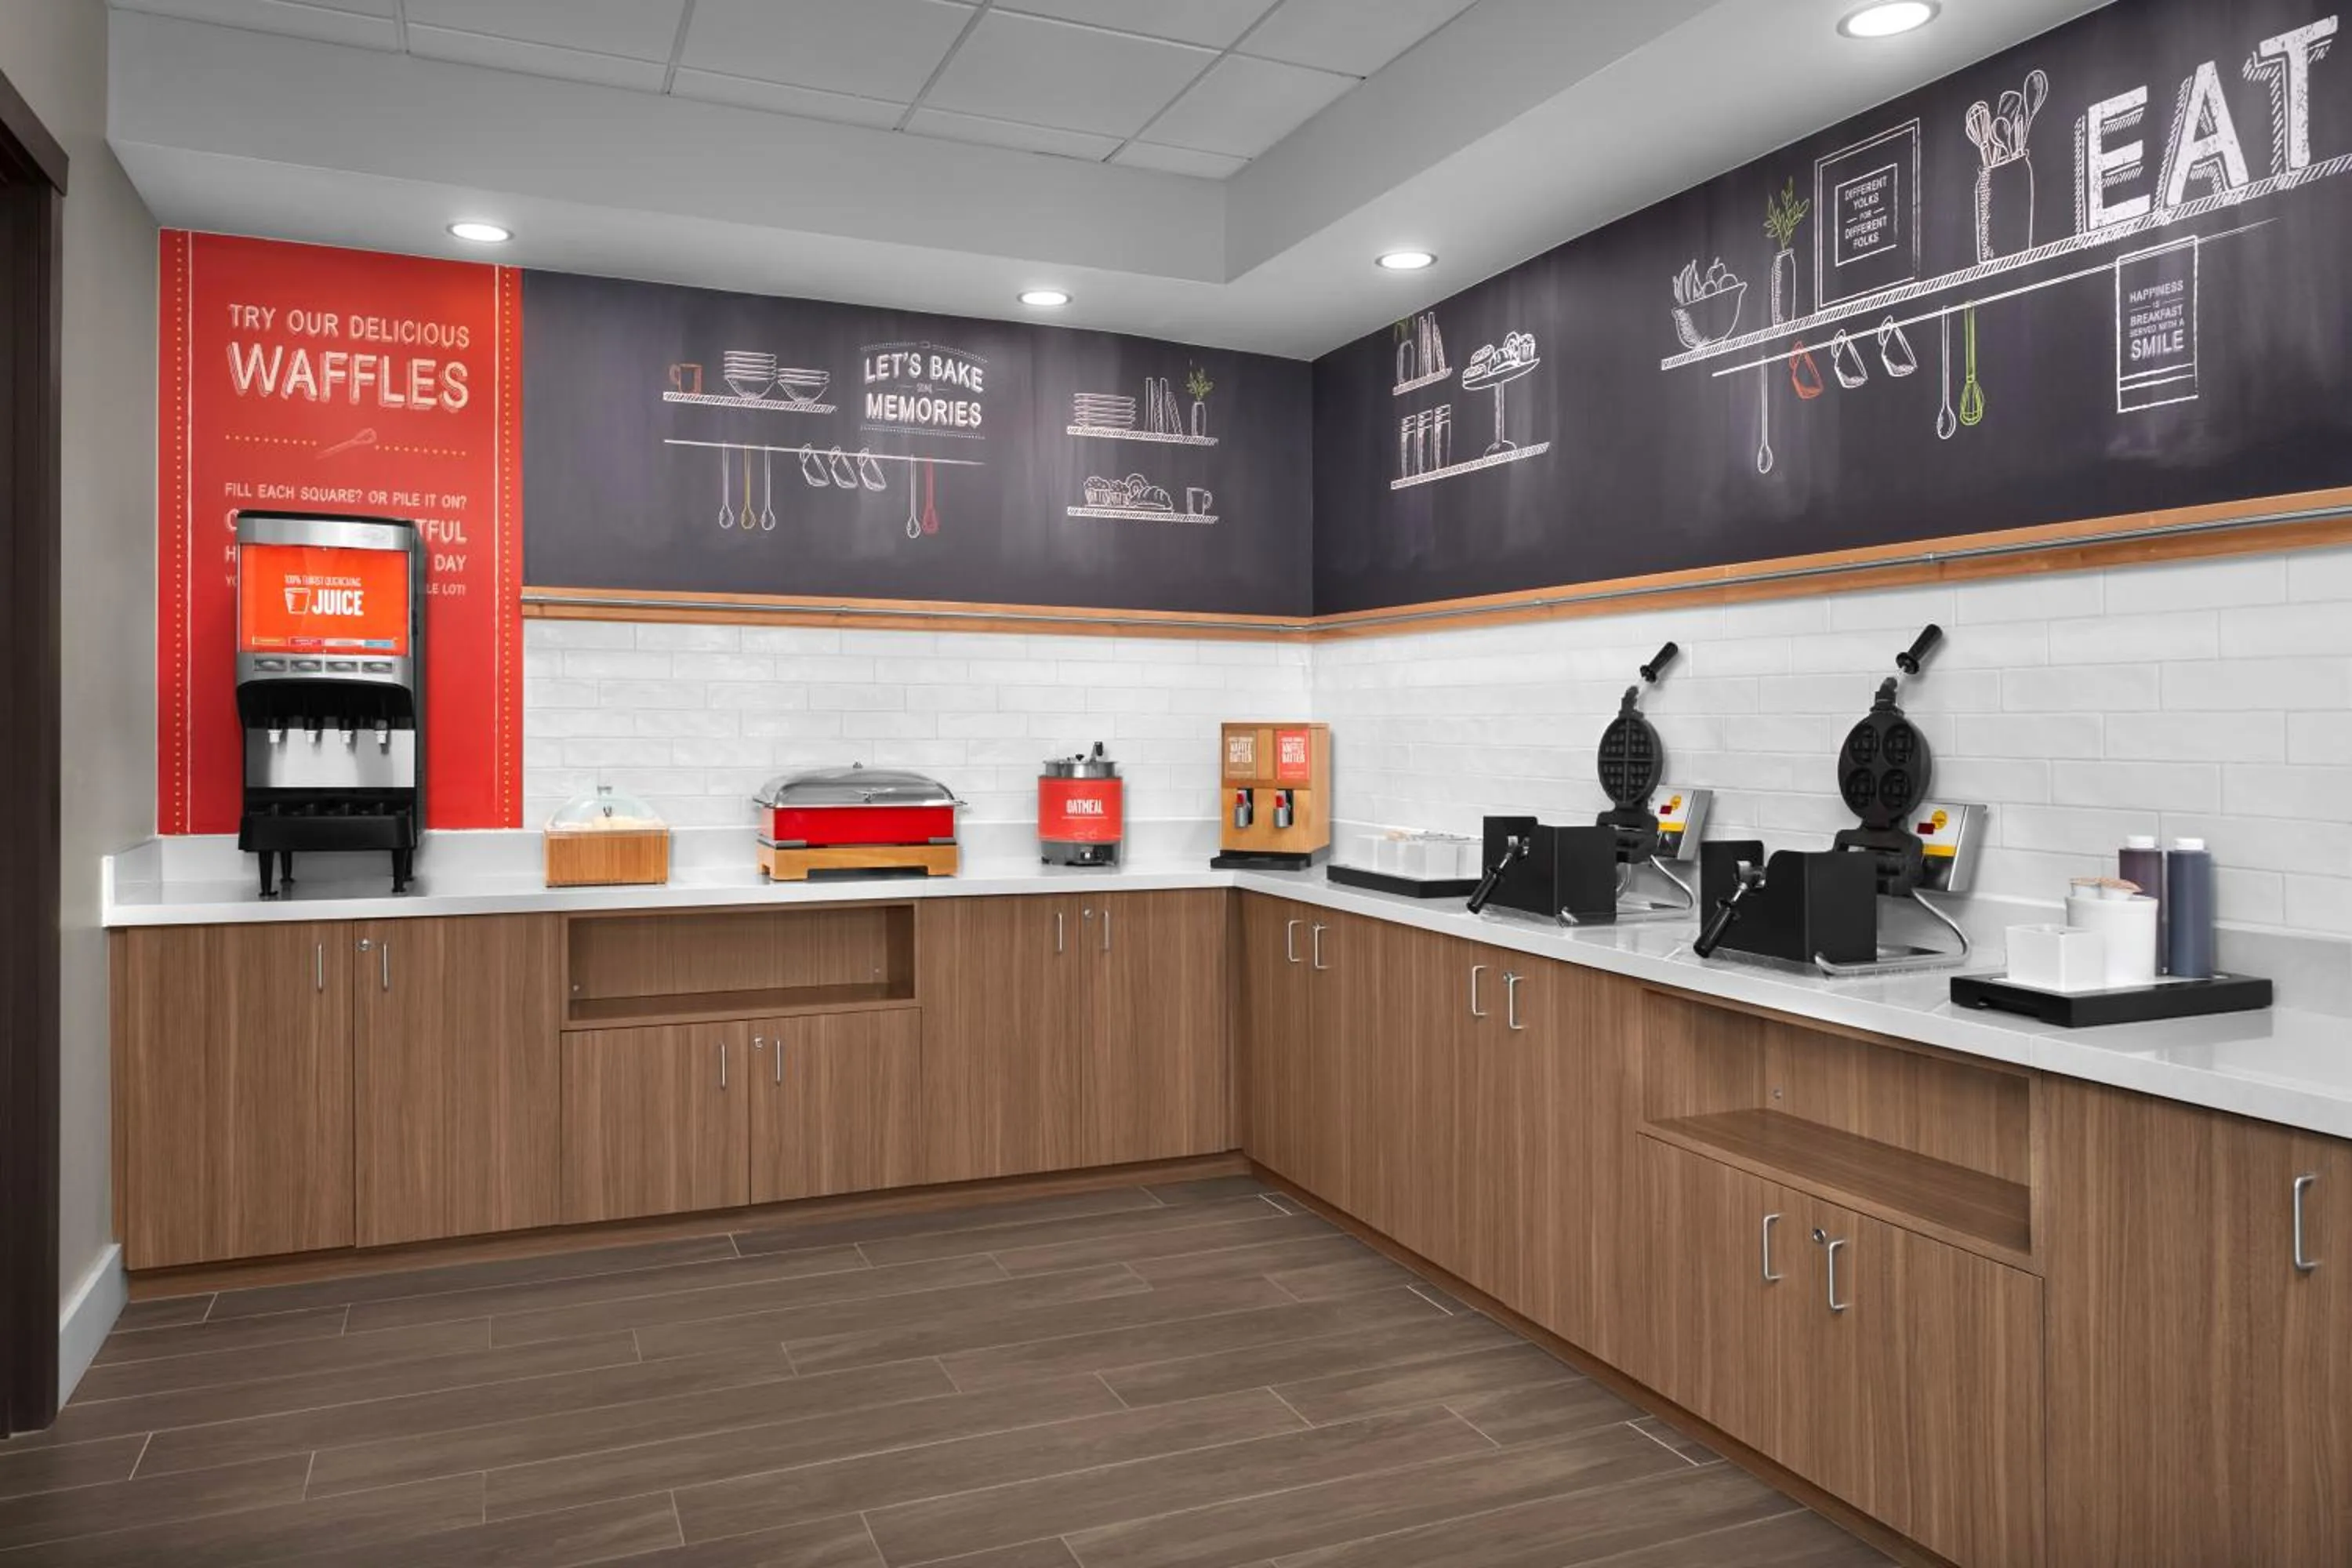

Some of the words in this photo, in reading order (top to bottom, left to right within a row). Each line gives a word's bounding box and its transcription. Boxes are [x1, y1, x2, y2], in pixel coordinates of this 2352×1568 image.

[2075, 15, 2339, 233] EAT
[1845, 176, 1887, 201] DIFFERENT
[1853, 192, 1879, 210] YOLKS
[1845, 216, 1887, 239] DIFFERENT
[1853, 232, 1879, 249] FOLKS
[2129, 280, 2183, 303] HAPPINESS
[230, 303, 276, 331] TRY
[288, 309, 339, 337] OUR
[350, 315, 470, 348] DELICIOUS
[2129, 325, 2157, 337] SERVED
[2158, 319, 2177, 330] WITH
[2179, 318, 2185, 327] A
[2130, 304, 2183, 326] BREAKFAST
[2131, 329, 2184, 360] SMILE
[227, 342, 469, 412] WAFFLES
[865, 351, 922, 385] LET'S
[929, 355, 984, 393] BAKE
[866, 393, 982, 429] MEMORIES
[225, 482, 252, 497] FILL
[258, 484, 295, 499] EACH
[300, 487, 363, 503] SQUARE?
[368, 490, 388, 505] OR
[393, 492, 421, 506] PILE
[425, 494, 437, 508] IT
[441, 495, 467, 510] ON?
[434, 554, 467, 572] DAY
[311, 589, 365, 616] JUICE
[1066, 798, 1104, 815] OATMEAL
